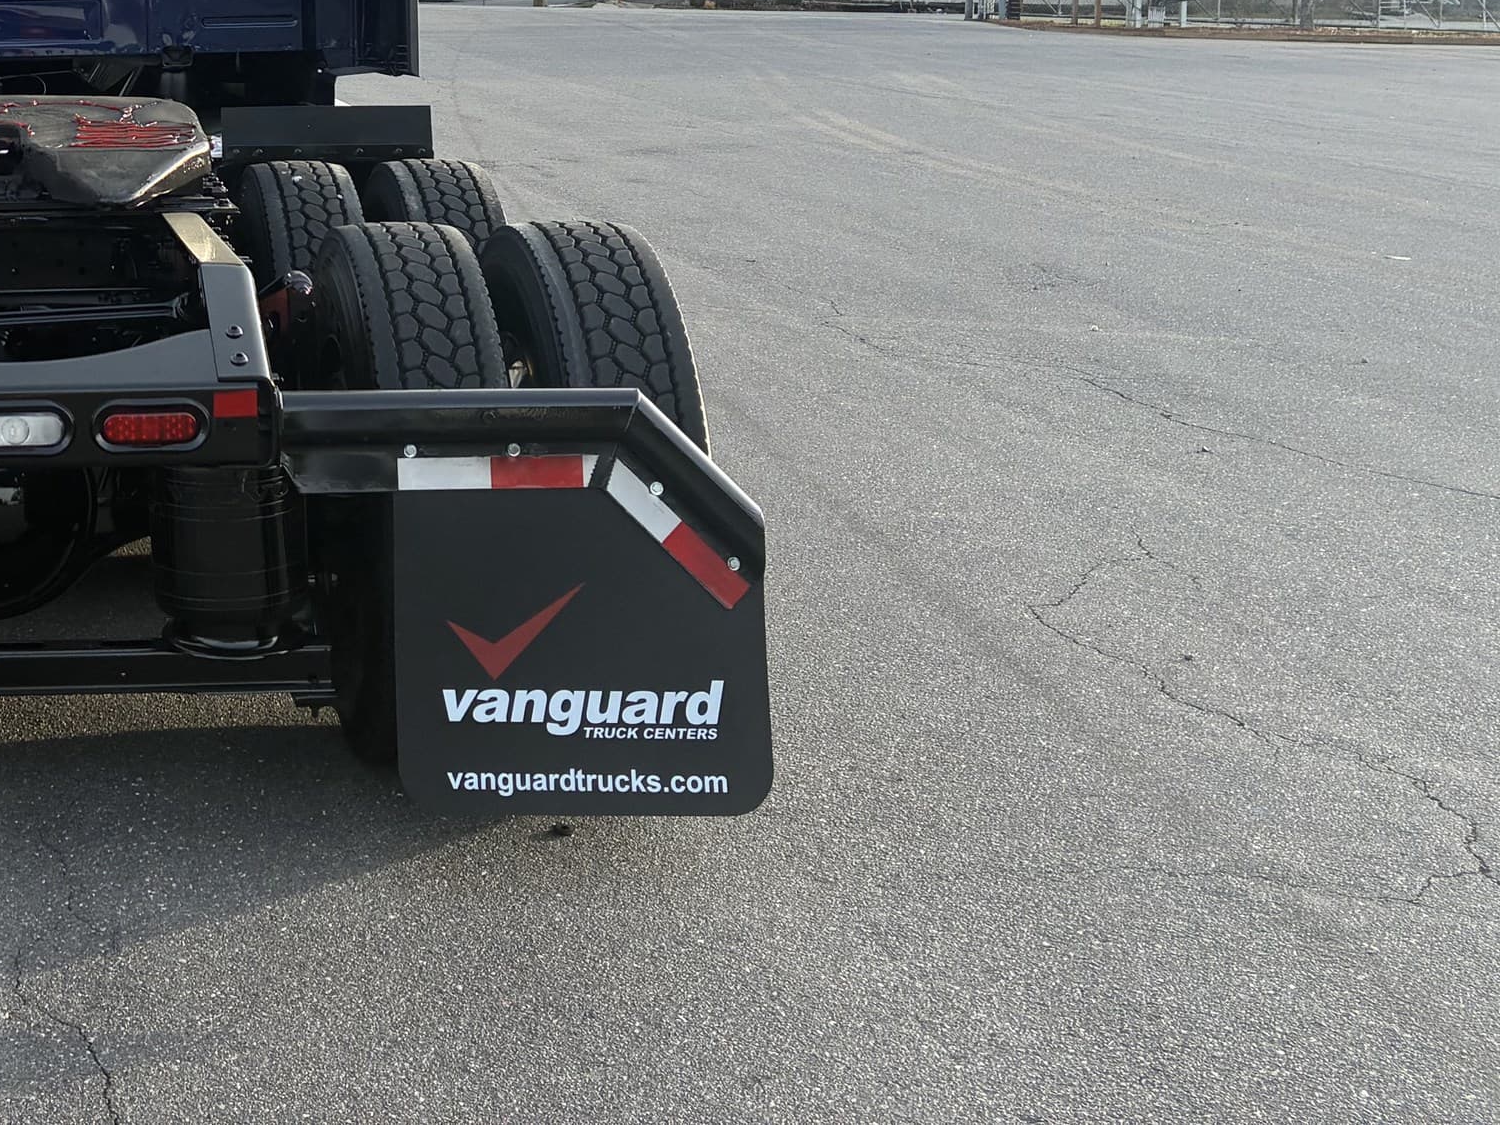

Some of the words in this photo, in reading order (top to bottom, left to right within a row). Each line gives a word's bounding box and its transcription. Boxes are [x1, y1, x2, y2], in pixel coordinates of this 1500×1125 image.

[442, 680, 725, 736] vanguard
[583, 727, 639, 739] TRUCK
[643, 727, 718, 740] CENTERS
[446, 768, 729, 797] vanguardtrucks.com
